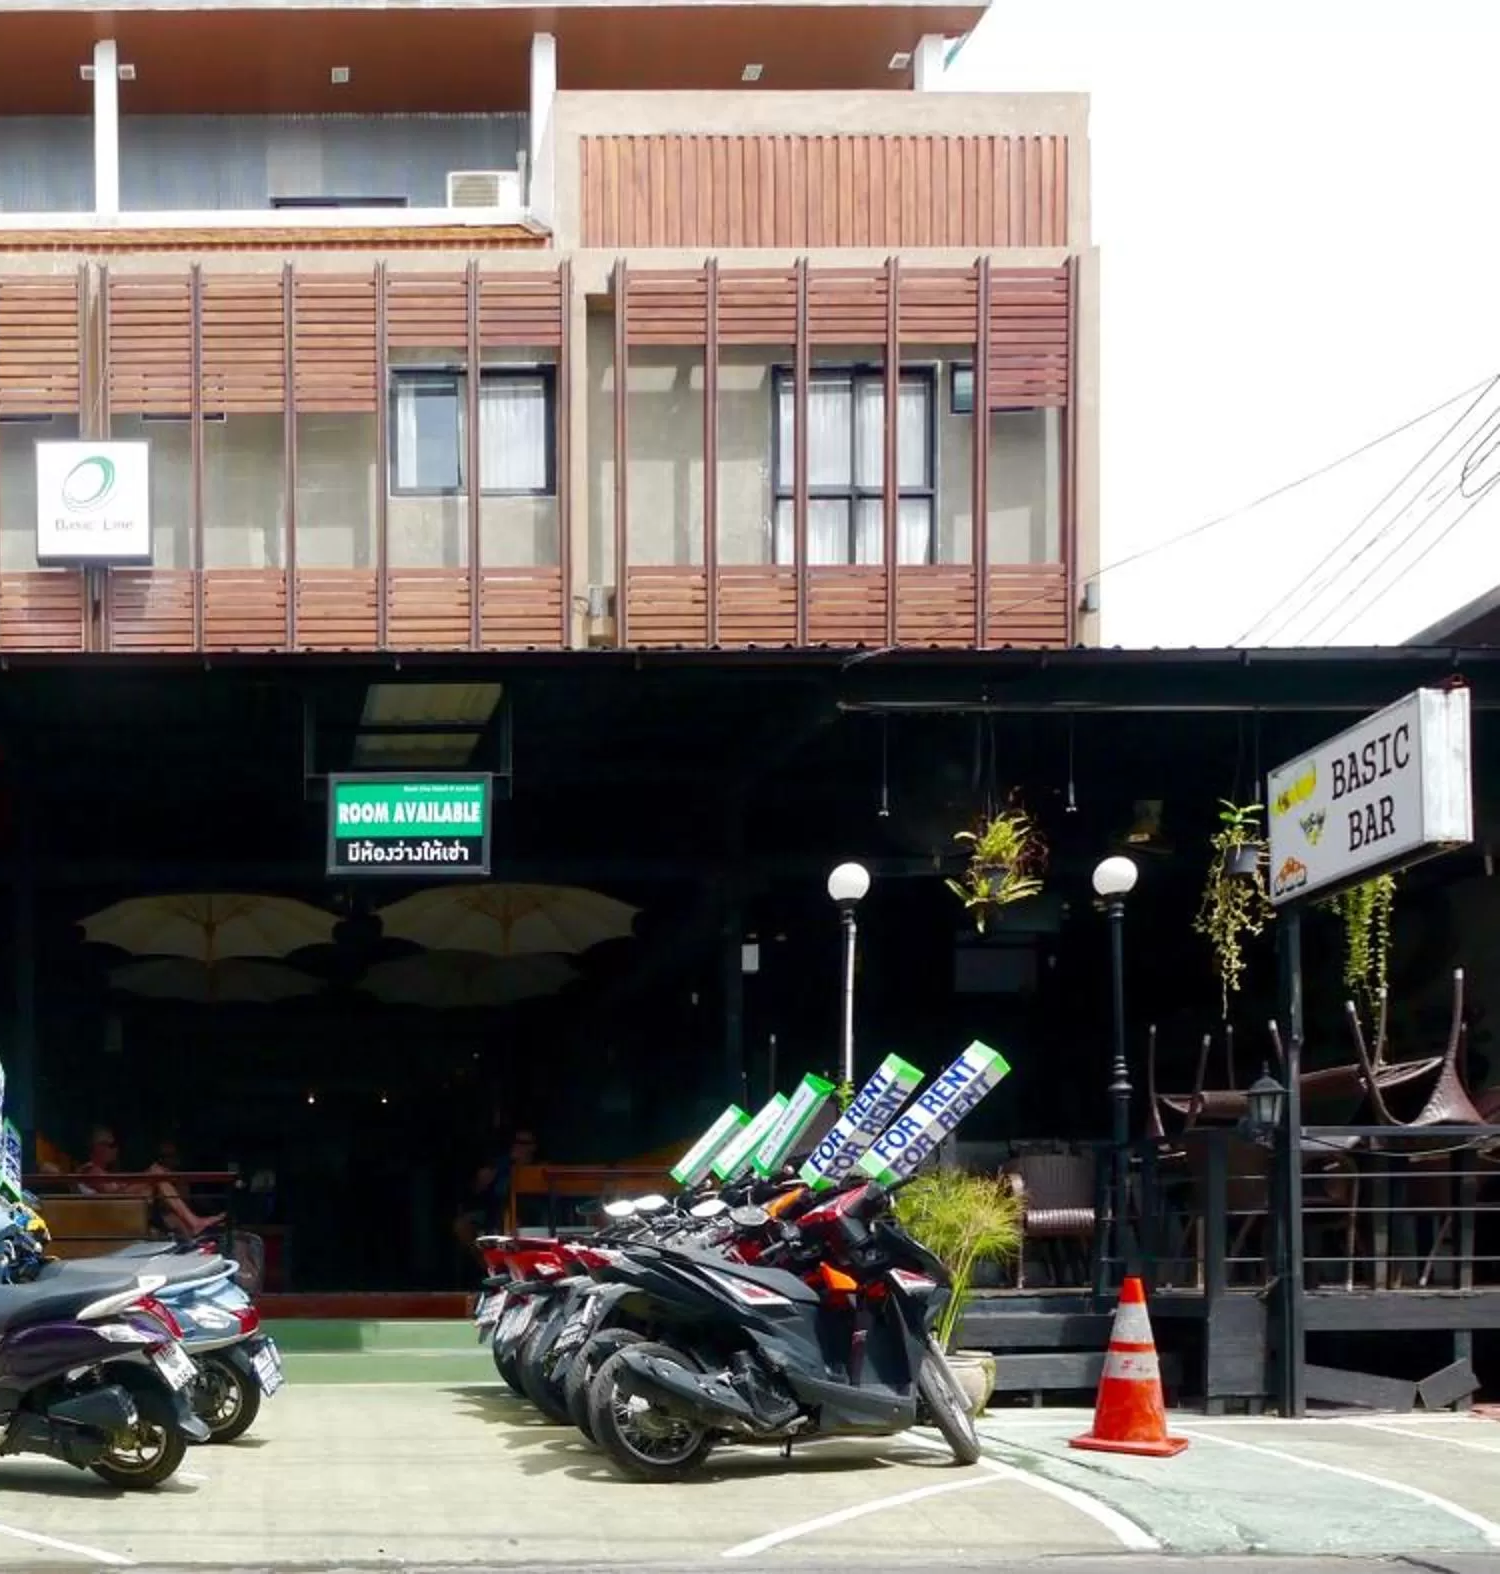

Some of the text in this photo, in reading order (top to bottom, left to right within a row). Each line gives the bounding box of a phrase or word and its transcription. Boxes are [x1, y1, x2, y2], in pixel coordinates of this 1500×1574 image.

[1331, 723, 1410, 800] BASIC
[338, 801, 482, 824] ROOM AVAILABLE
[348, 840, 469, 863] มีห้องว่างให้เช่า
[1348, 795, 1397, 851] BAR
[809, 1069, 889, 1172] FOR RENT
[823, 1081, 909, 1180] FOR RENT
[872, 1056, 978, 1161] FOR RENT
[889, 1072, 991, 1177] FOR RENT
